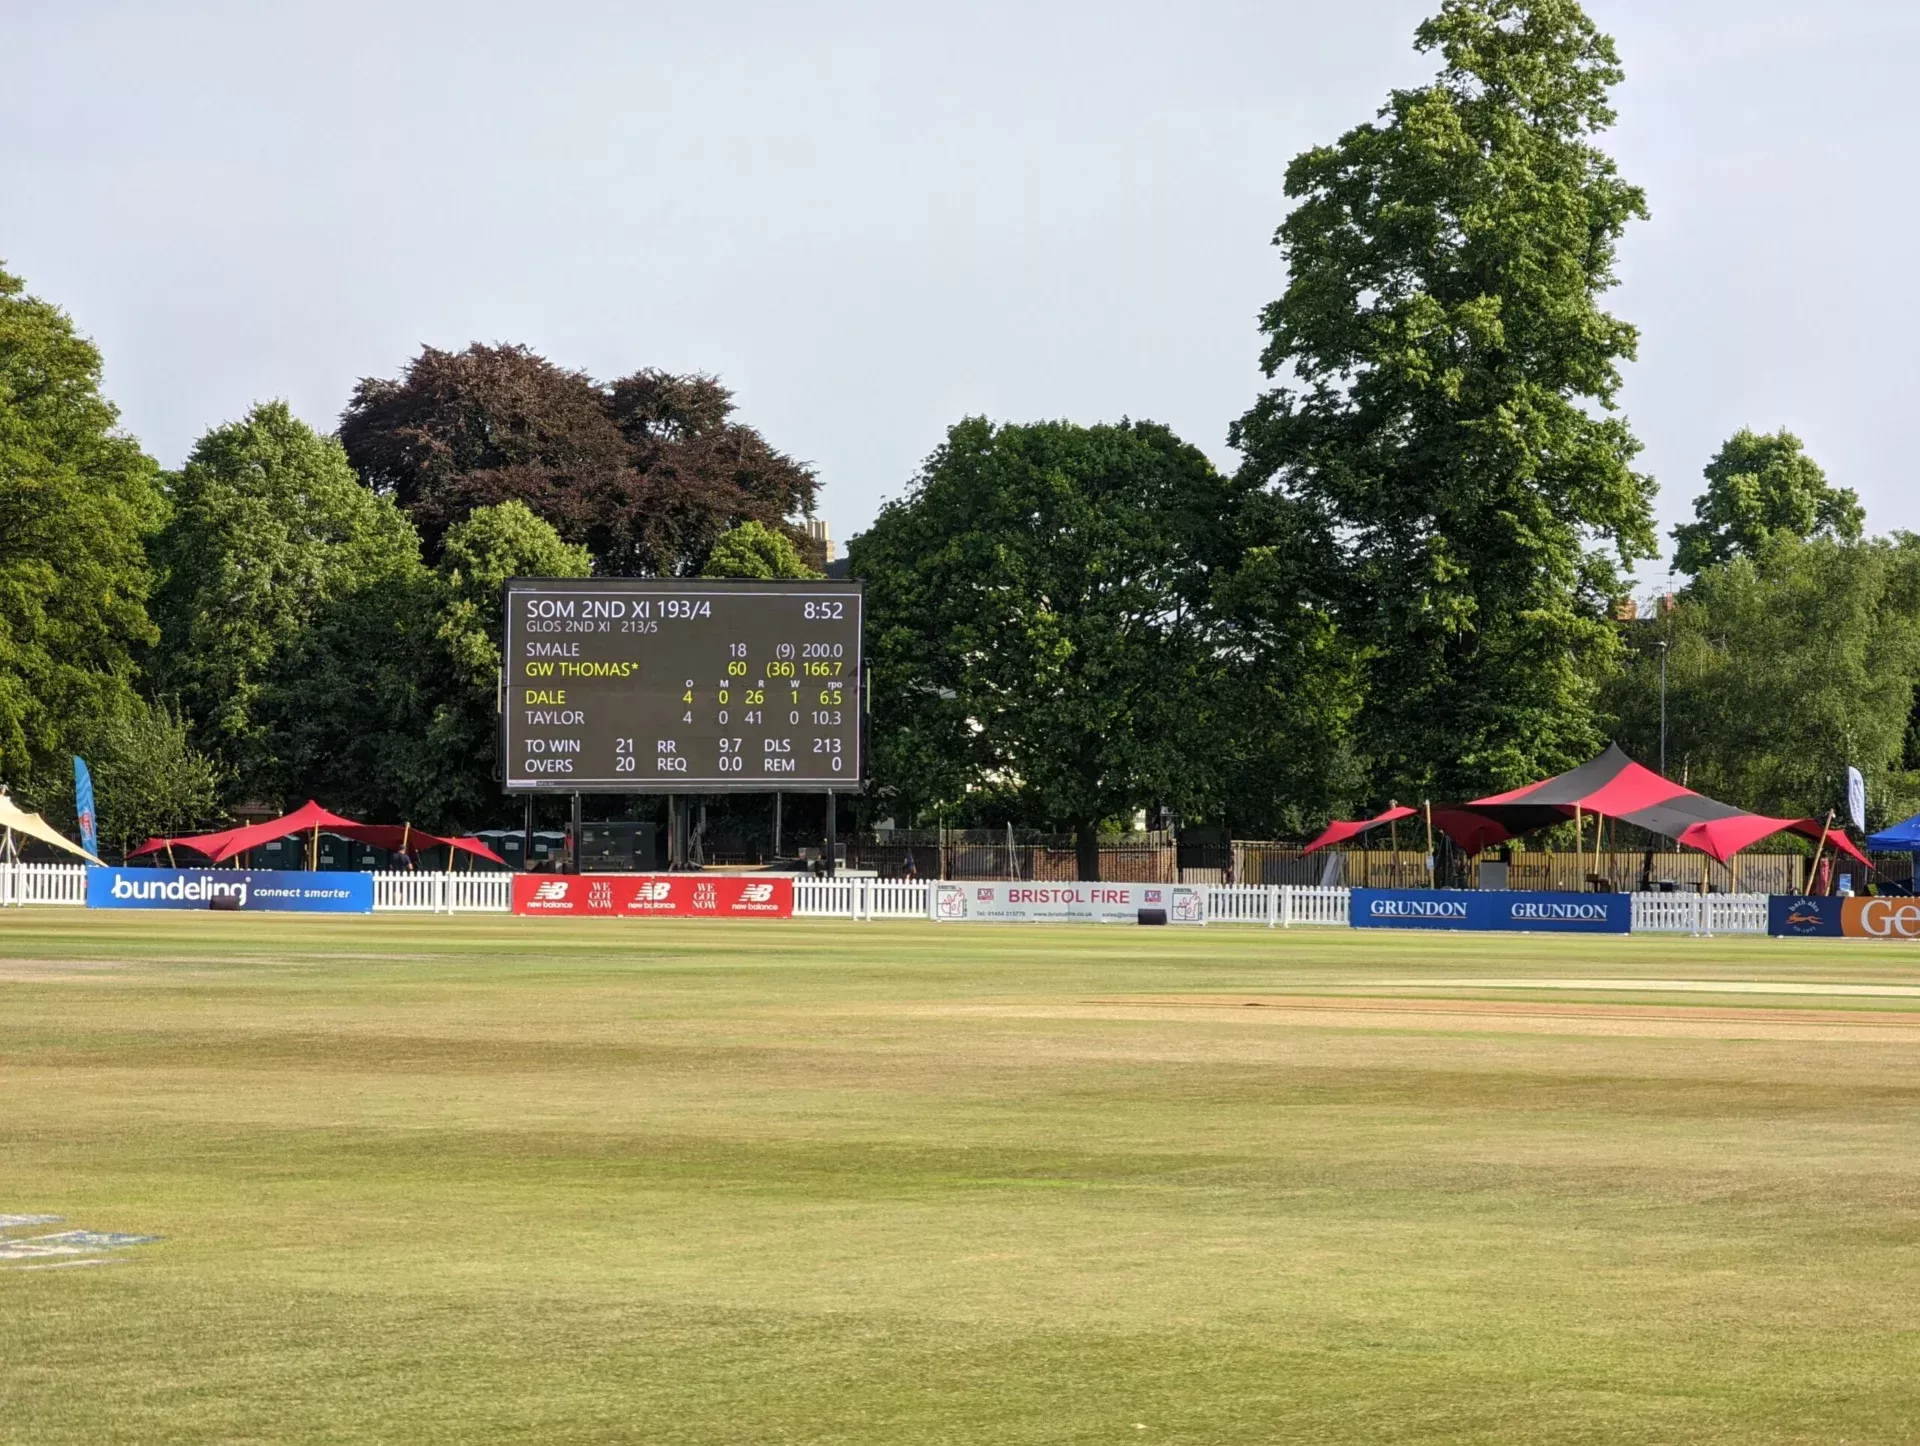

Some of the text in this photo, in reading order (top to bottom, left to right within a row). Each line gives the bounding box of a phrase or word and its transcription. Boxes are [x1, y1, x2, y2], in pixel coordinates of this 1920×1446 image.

[527, 601, 711, 619] SOM 2ND XI 193/4
[804, 603, 842, 619] 8:52
[527, 621, 658, 633] GLOS 2ND XI 213/5
[526, 643, 842, 659] SMALE 18 (9) 200.0
[526, 663, 555, 676] GW
[728, 663, 746, 676] 60
[767, 663, 795, 677] (36)
[804, 663, 842, 676] 166.7
[526, 691, 841, 704] DALE 4 0 26 1 6.5
[526, 712, 841, 725] TAYLOR 4 0 41 0 10.3
[526, 739, 841, 753] TO WIN 21 RR 9.7 DLS 213
[526, 759, 841, 773] OVERS 20 REQ 0.0 REM 0
[112, 874, 350, 906] bundeling connect smarter
[593, 882, 610, 890] WE
[697, 883, 715, 891] WE
[589, 891, 612, 900] GOT
[694, 892, 716, 900] GOT
[1009, 890, 1130, 903] BRISTOL FIRE
[588, 900, 612, 908] NOW
[692, 900, 716, 909] NOW
[1371, 901, 1467, 916] GRUNDON
[1788, 899, 1819, 912] bath ales
[1512, 903, 1607, 919] GRUNDON
